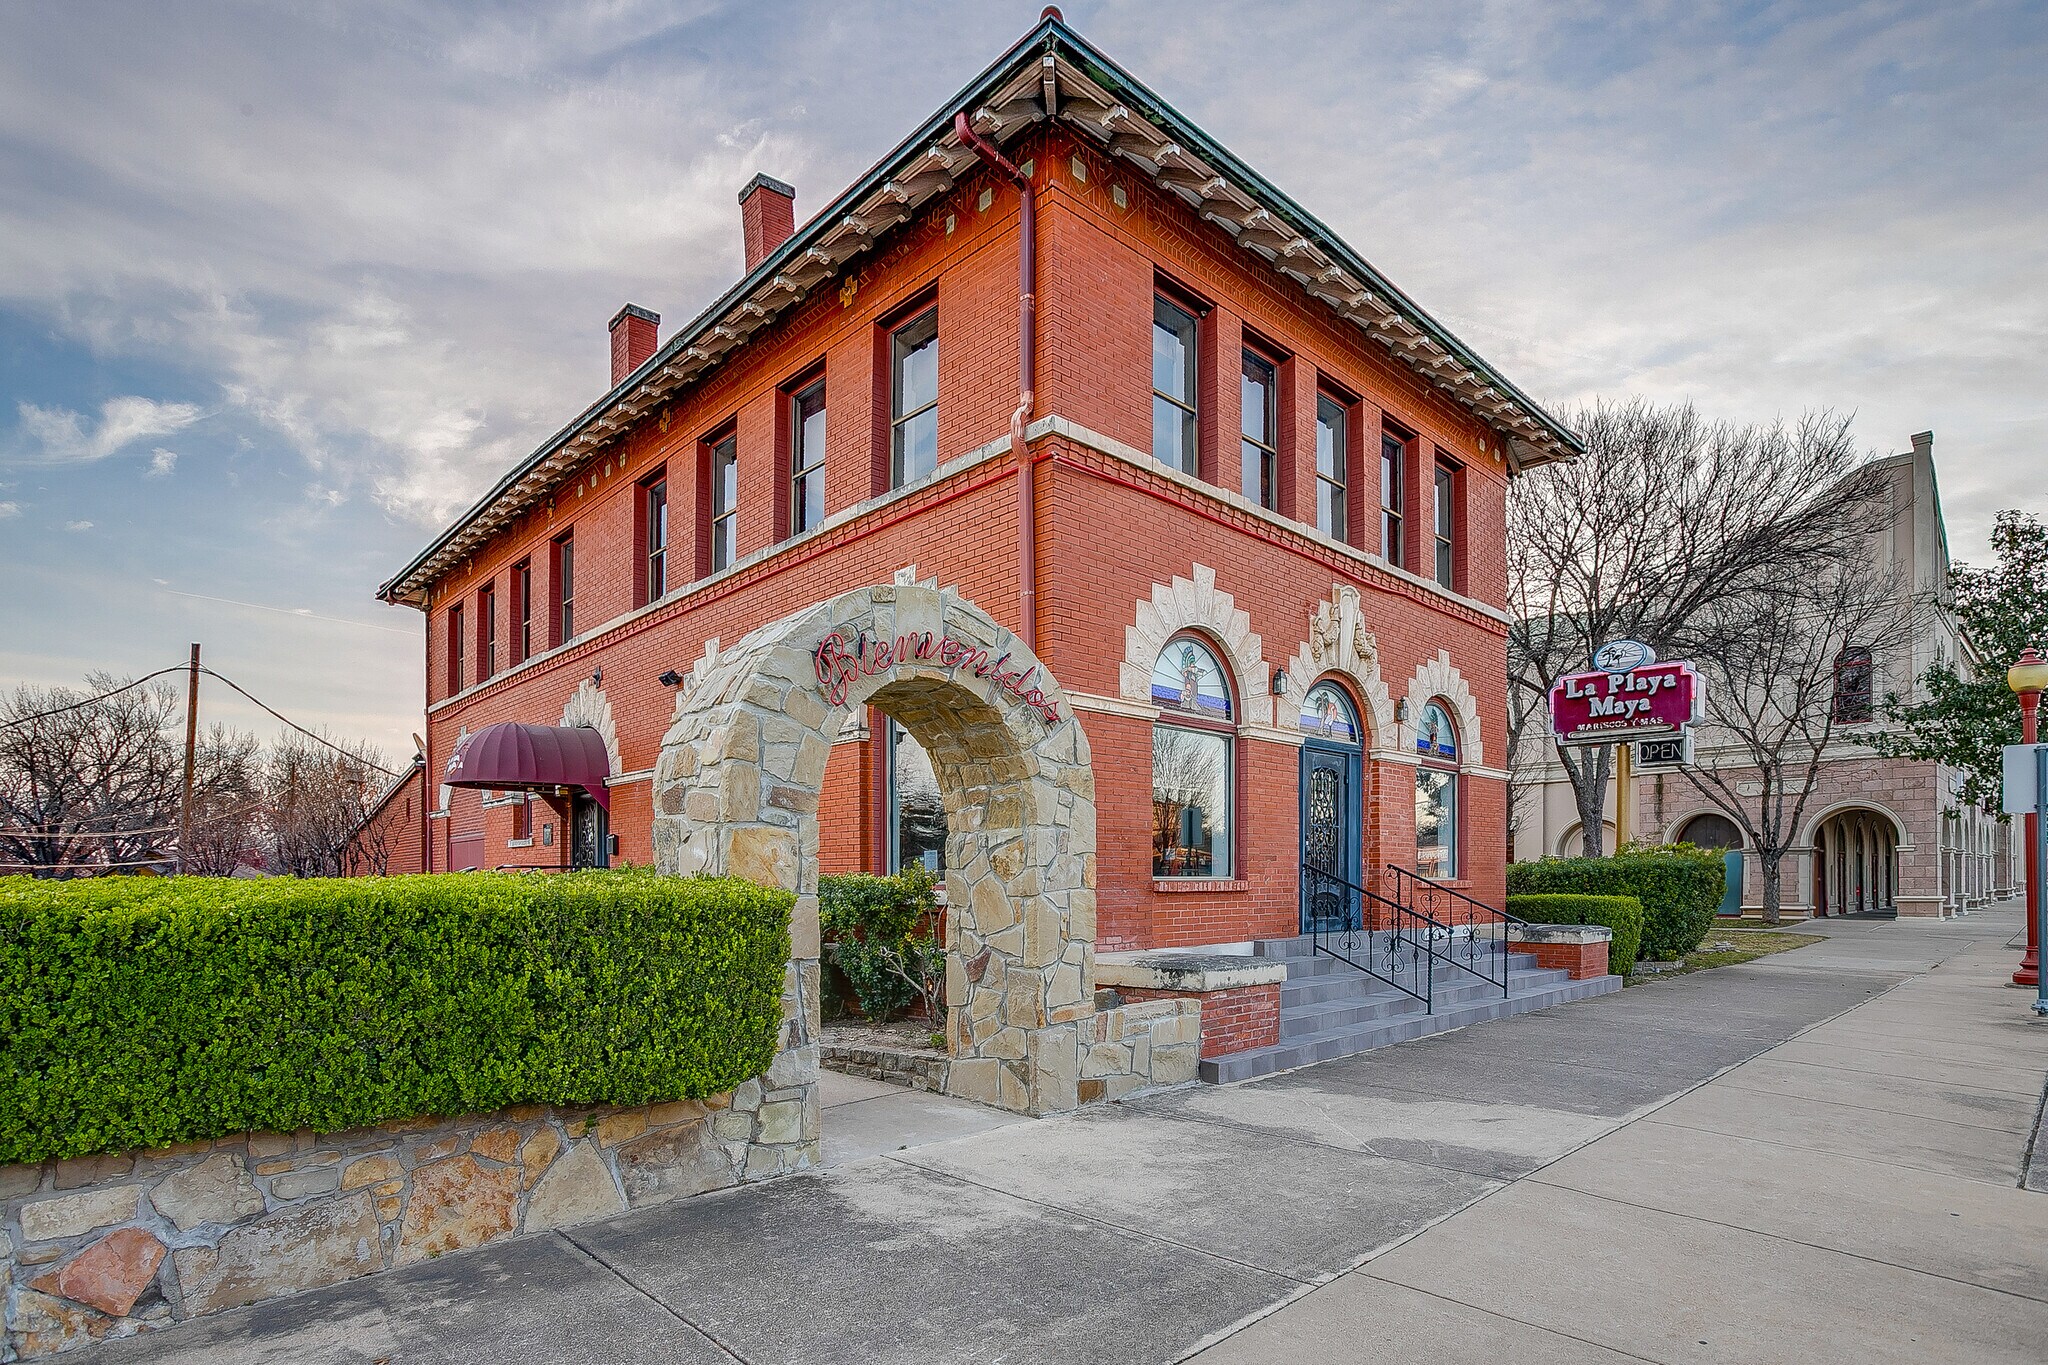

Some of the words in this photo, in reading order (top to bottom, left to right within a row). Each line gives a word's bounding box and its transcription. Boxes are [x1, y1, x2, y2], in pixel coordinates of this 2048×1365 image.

[815, 631, 1060, 722] Bienvenidos
[1565, 679, 1596, 699] La
[1608, 673, 1676, 695] Playa
[1589, 696, 1650, 719] Maya
[1576, 720, 1628, 731] MARISCOS
[1641, 743, 1682, 761] OPEN
